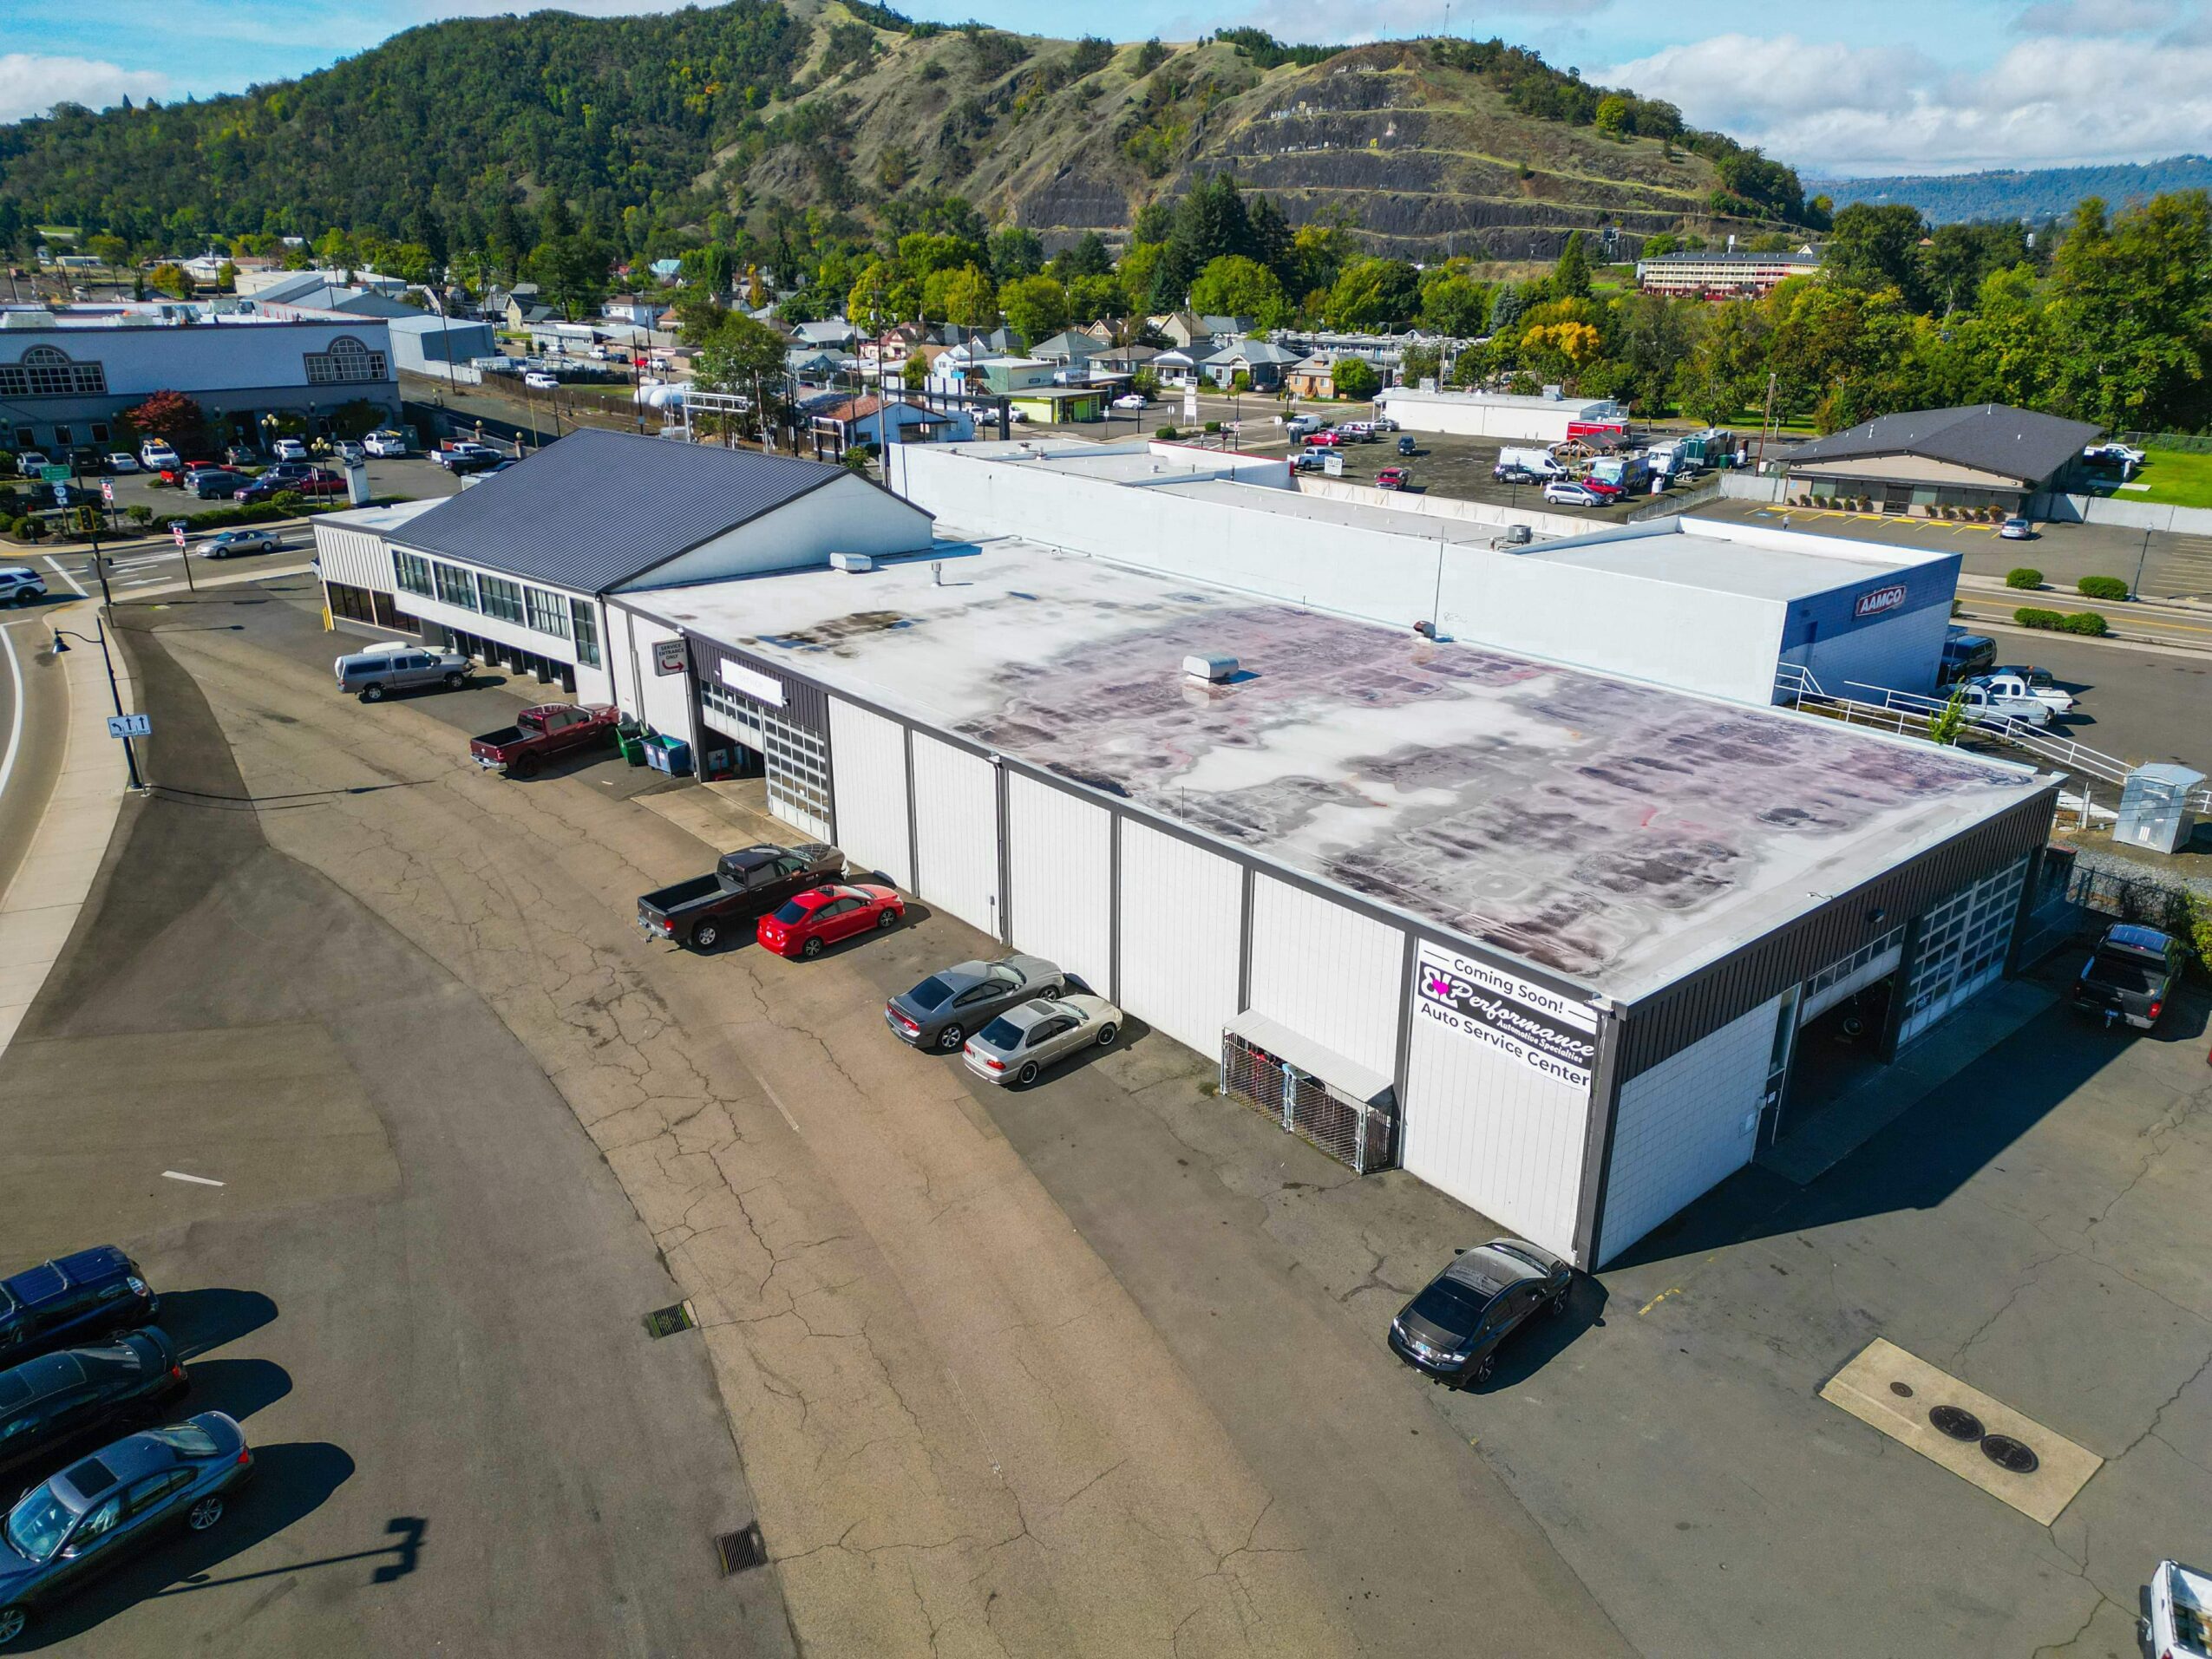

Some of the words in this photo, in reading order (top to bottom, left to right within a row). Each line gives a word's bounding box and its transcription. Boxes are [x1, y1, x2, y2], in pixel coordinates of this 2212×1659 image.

[1860, 589, 1903, 613] AAMCO
[658, 648, 684, 656] ENTRANCE
[1454, 958, 1514, 994] Coming
[1518, 984, 1564, 1014] Soon!
[1450, 980, 1594, 1056] Performance
[1496, 1019, 1538, 1044] Automotive
[1539, 1040, 1583, 1063] Specialties
[1421, 1003, 1458, 1028] Auto
[1463, 1020, 1522, 1058] Service
[1528, 1051, 1590, 1086] Center
